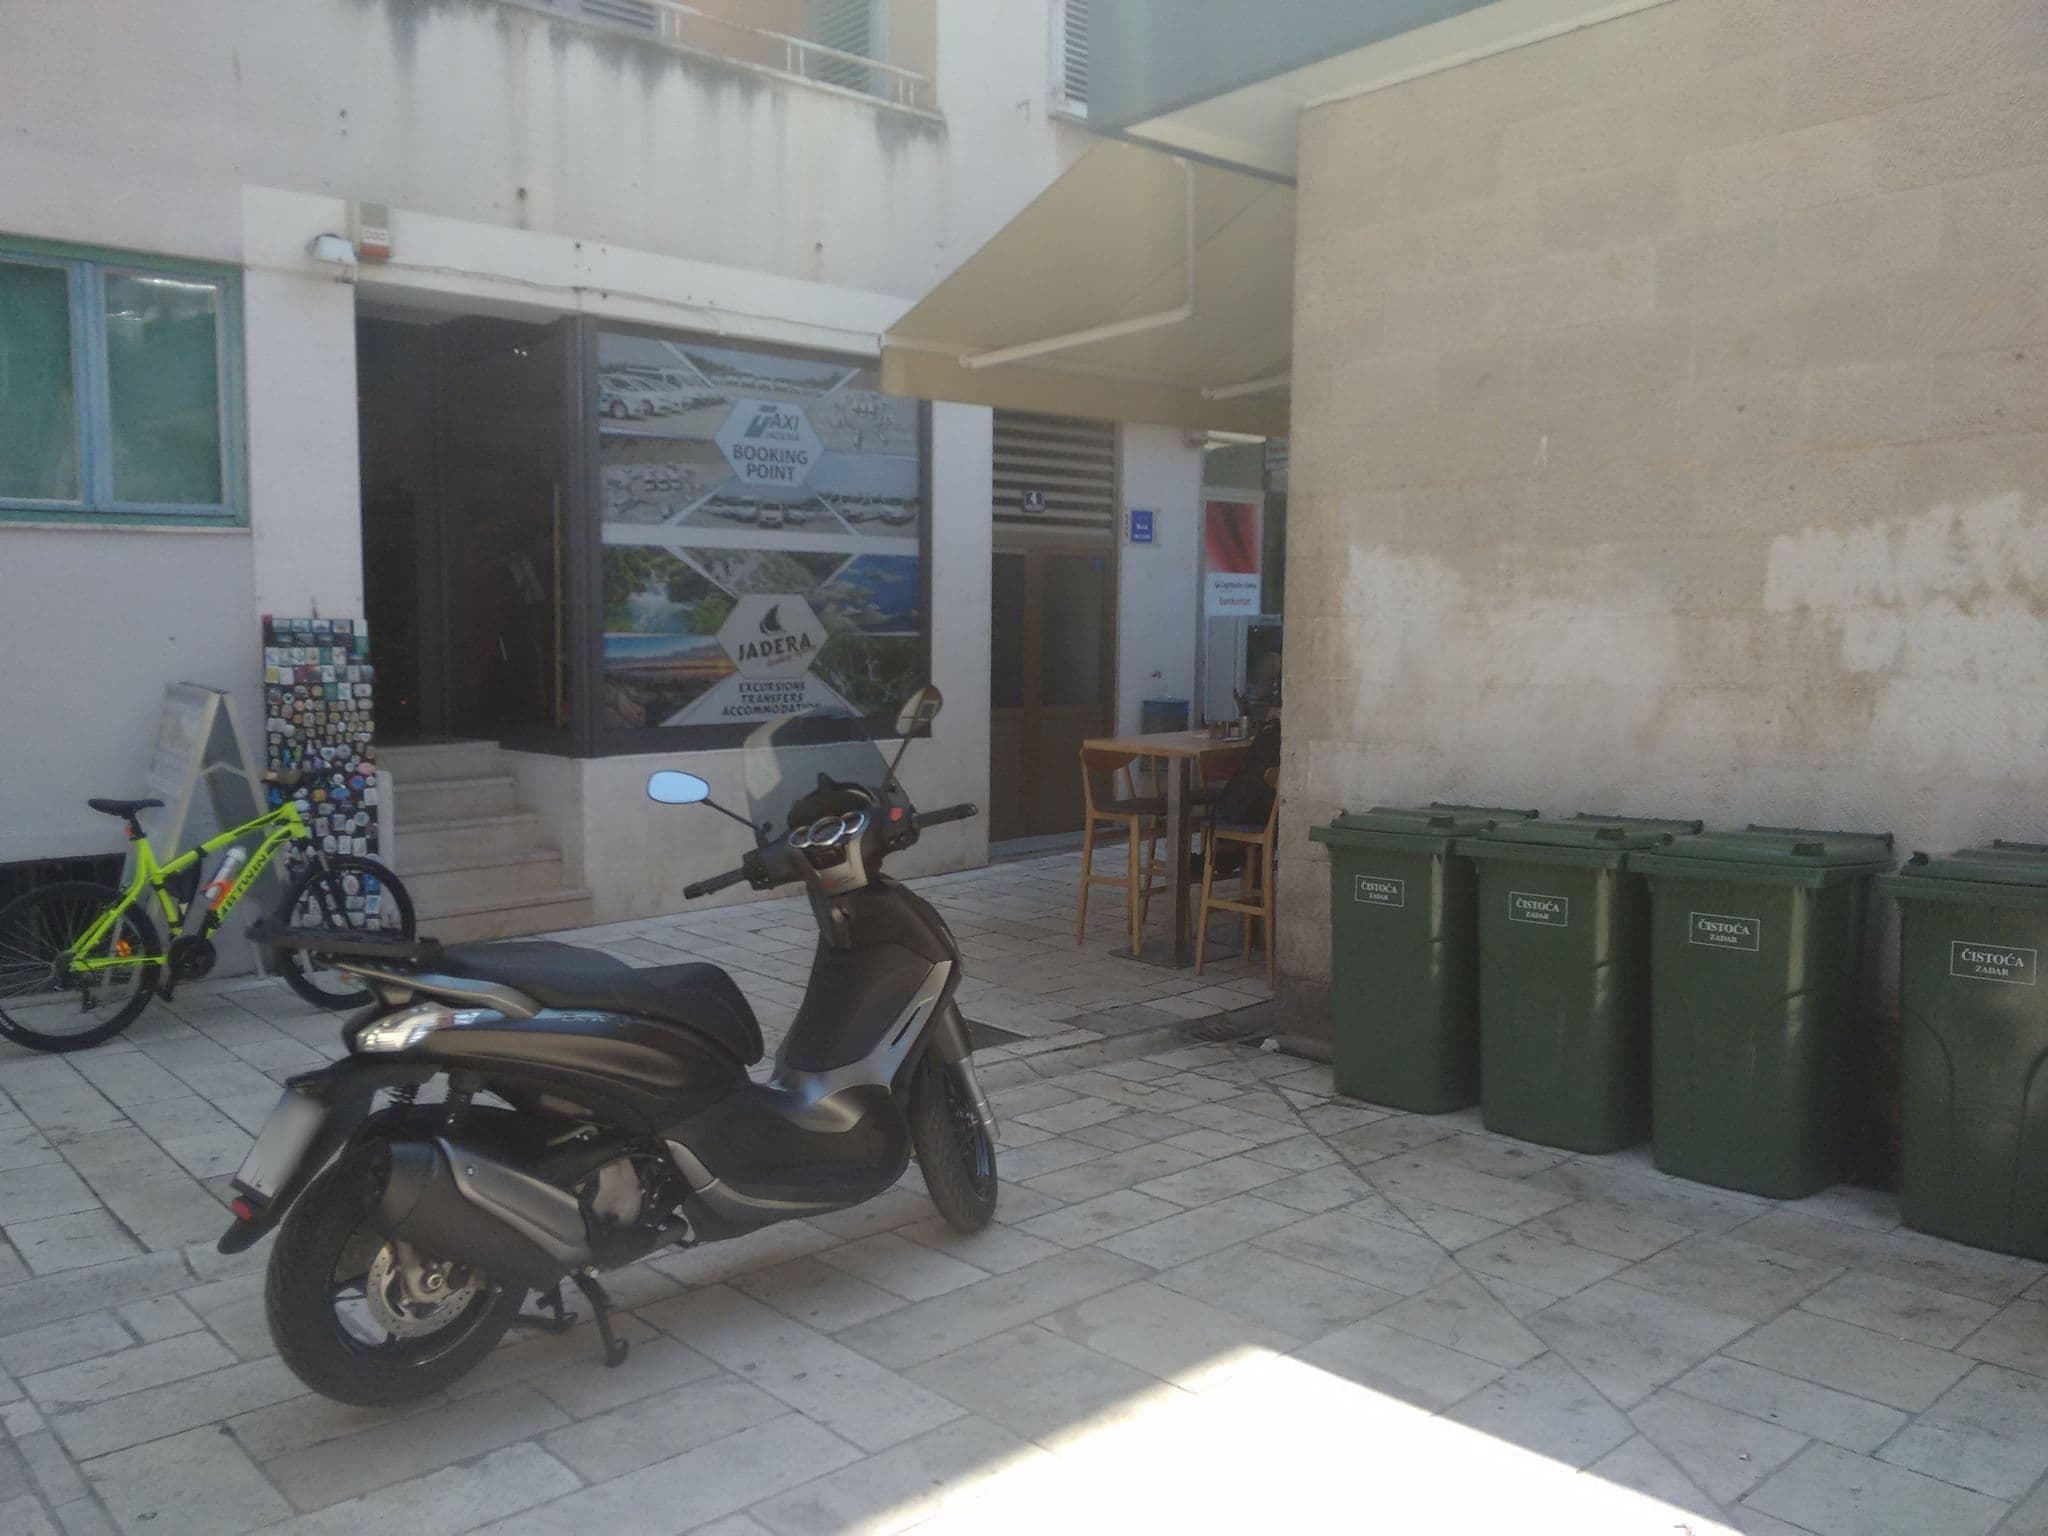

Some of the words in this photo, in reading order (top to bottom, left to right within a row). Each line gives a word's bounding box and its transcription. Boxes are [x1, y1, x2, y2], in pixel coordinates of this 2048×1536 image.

[733, 443, 808, 465] BOOKING
[746, 462, 795, 480] POINT
[737, 632, 811, 661] JADERA
[738, 681, 806, 693] EXCURSIONS
[741, 693, 804, 705] TRANSFERS
[1360, 880, 1398, 894] ČISTOĆA
[1516, 896, 1560, 912] ČISTOĆA
[1698, 918, 1750, 936] ČISTOĆA
[1709, 933, 1738, 944] ZADAR
[1960, 947, 2024, 968] ČISTOĆA
[1975, 964, 2009, 977] ZADAR
